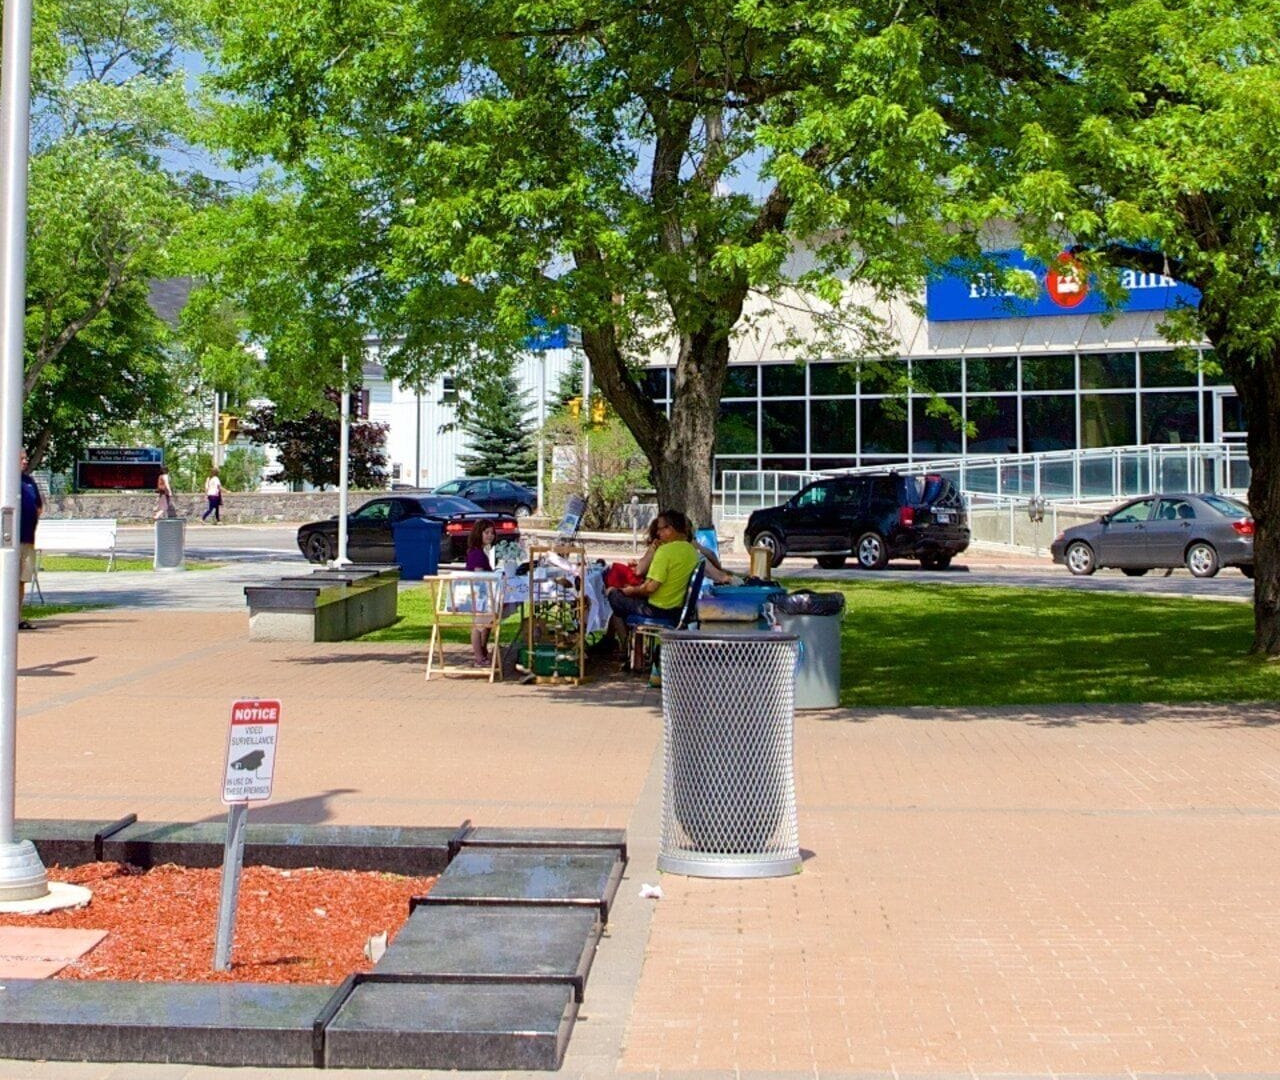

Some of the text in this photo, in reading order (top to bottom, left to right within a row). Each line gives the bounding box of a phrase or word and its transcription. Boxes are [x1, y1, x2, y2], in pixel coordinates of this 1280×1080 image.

[234, 708, 278, 720] NOTICE
[245, 726, 263, 734] VIDEO
[231, 736, 275, 746] SURVEILLANCE
[245, 777, 253, 785] ON
